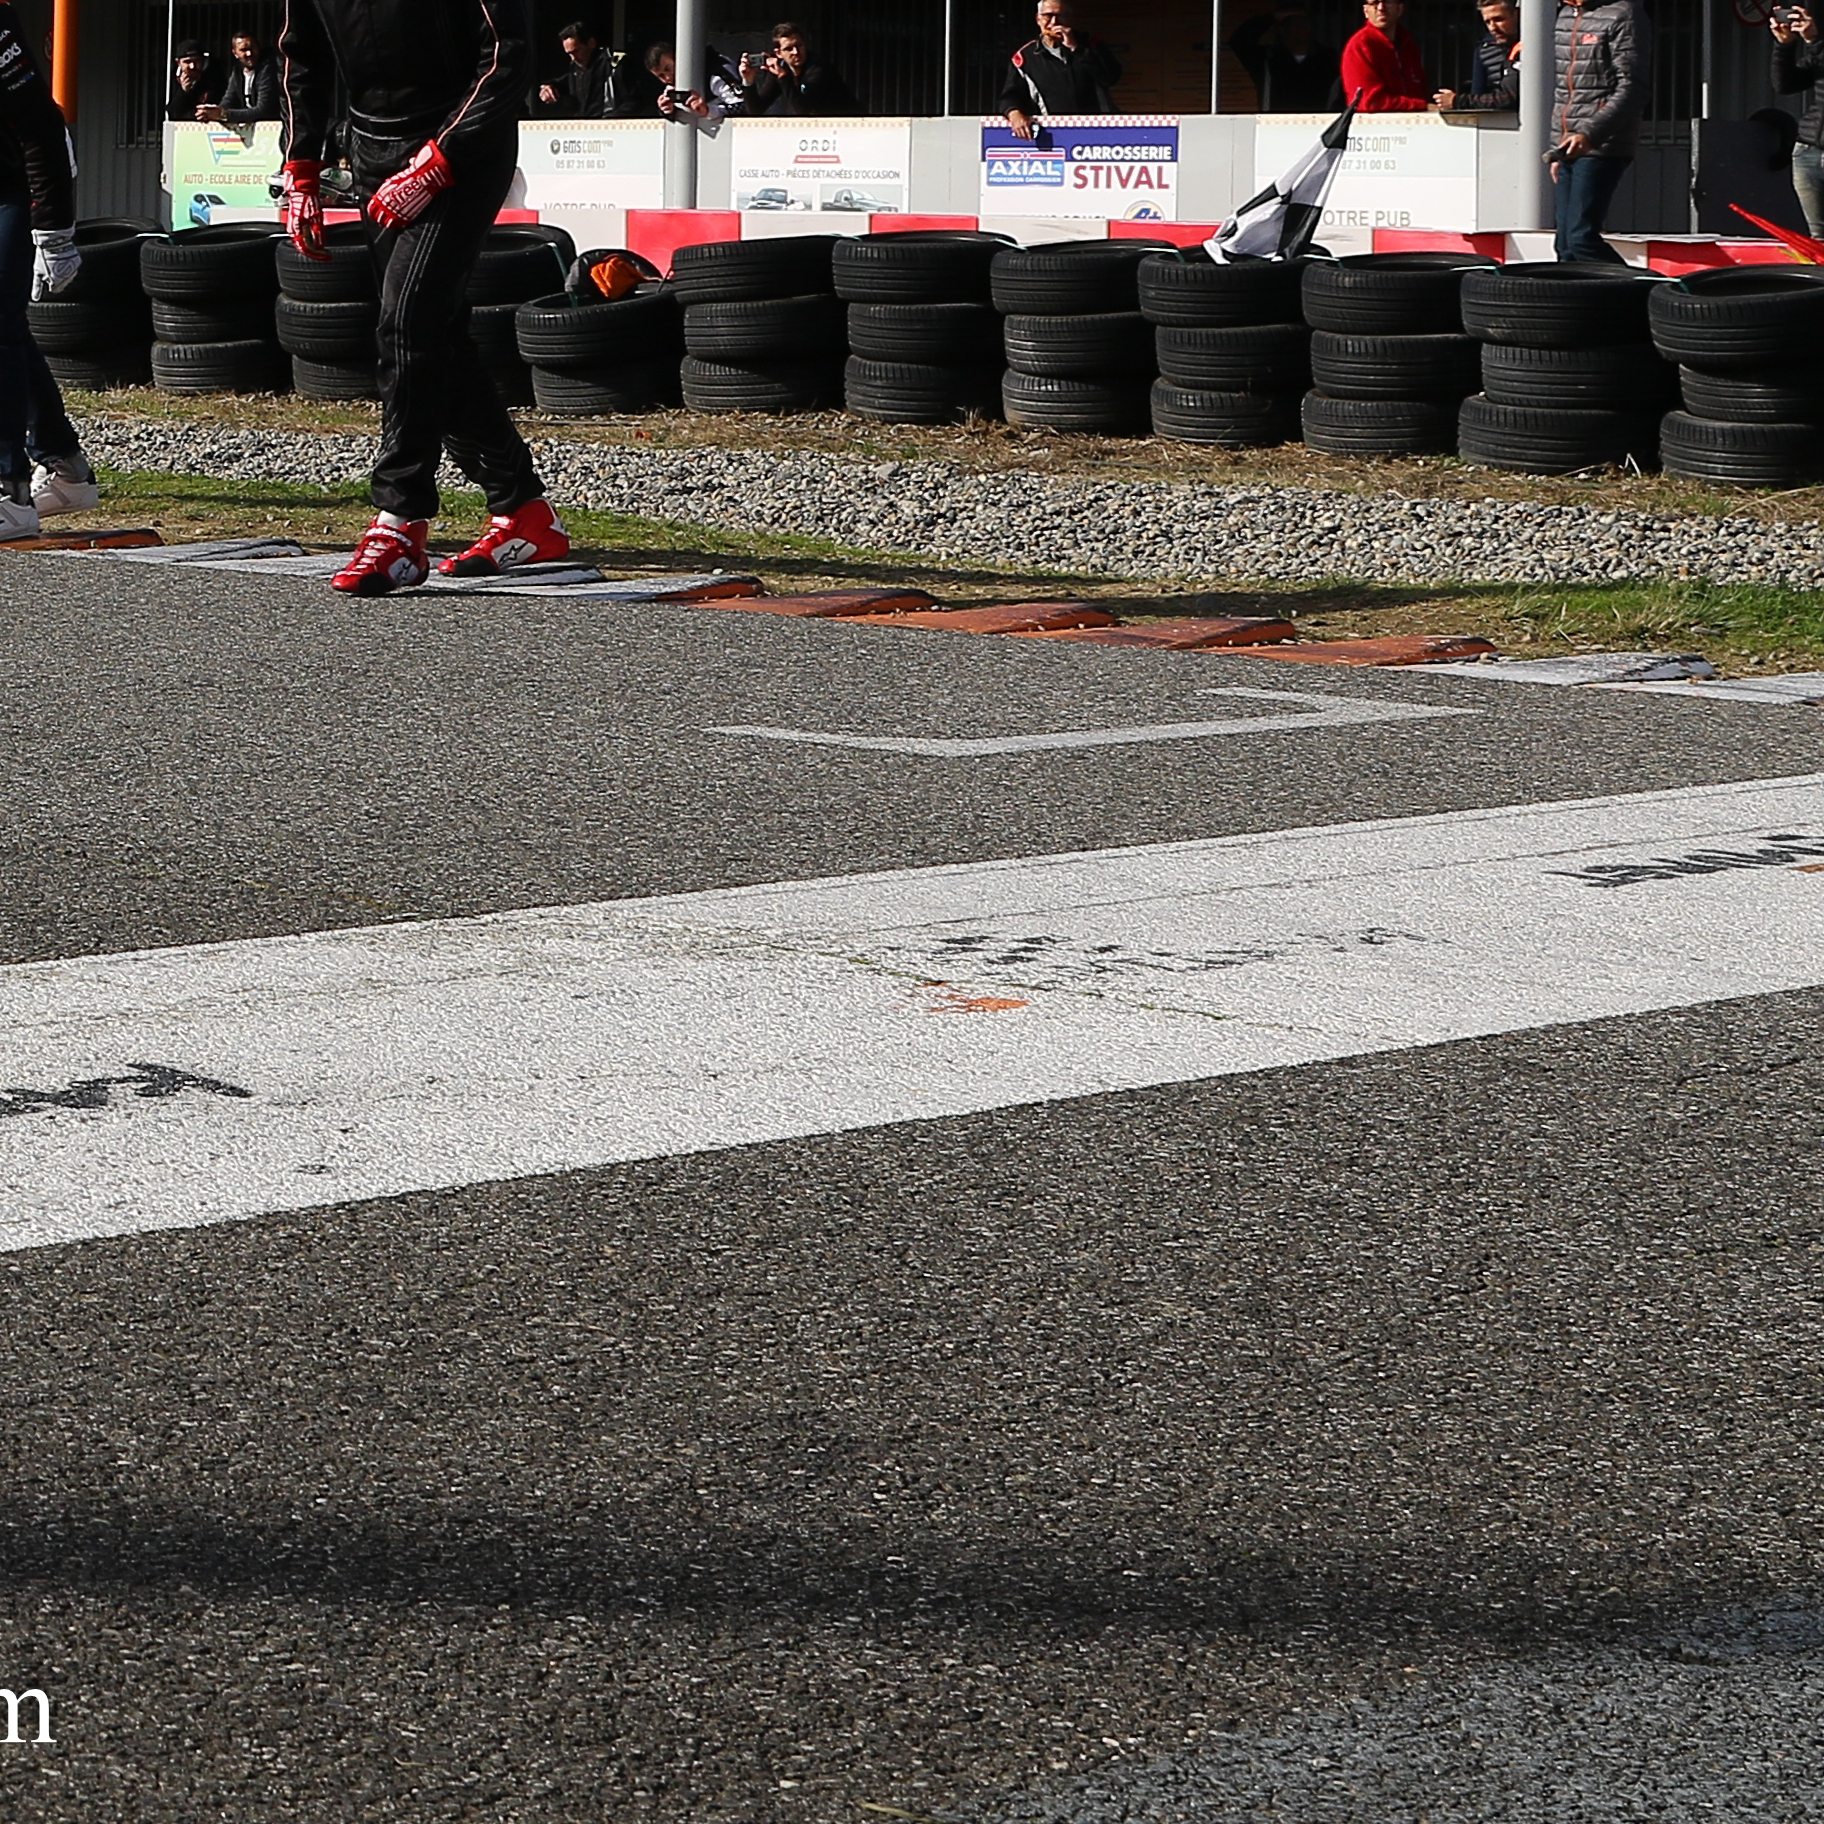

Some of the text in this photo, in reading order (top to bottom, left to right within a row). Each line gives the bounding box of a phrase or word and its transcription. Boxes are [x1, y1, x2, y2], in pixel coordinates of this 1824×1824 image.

[1071, 145, 1173, 161] CARROSSERIE
[989, 160, 1062, 176] AXIAL
[1355, 159, 1367, 171] 31
[1369, 159, 1382, 171] 00
[183, 173, 204, 185] AUTO
[209, 173, 233, 185] ECOLE
[234, 173, 252, 185] AIRE
[252, 173, 264, 185] DE
[738, 168, 759, 179] CASSE
[760, 168, 781, 179] AUTO
[786, 167, 811, 179] PIÈCES
[812, 167, 853, 180] DÉTACHÉES
[854, 169, 901, 180] D'OCCASION
[1072, 164, 1170, 190] STIVAL
[1322, 210, 1411, 227] OTRE PUB
